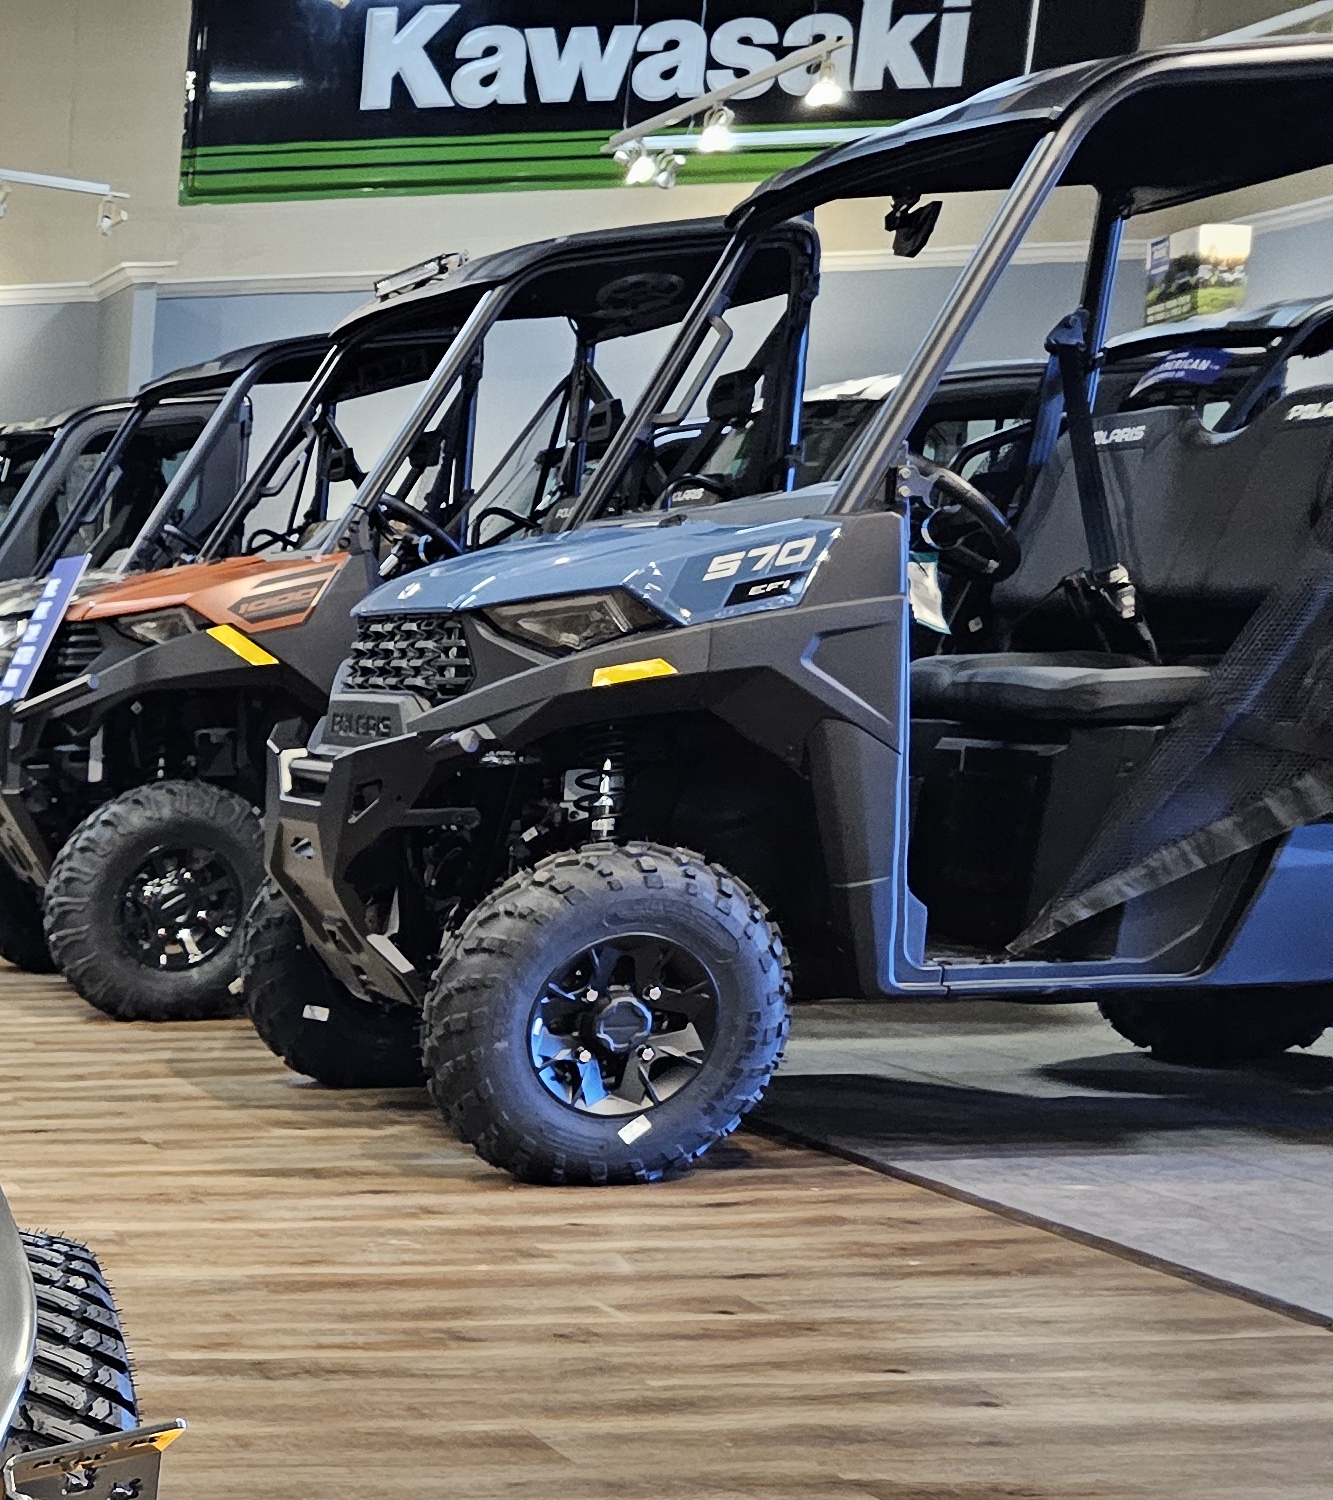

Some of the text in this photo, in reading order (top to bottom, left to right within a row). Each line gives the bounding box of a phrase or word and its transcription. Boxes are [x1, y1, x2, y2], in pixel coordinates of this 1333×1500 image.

[359, 0, 972, 111] Kawasaki
[1284, 400, 1333, 420] POLA
[702, 536, 818, 582] 570
[238, 587, 318, 614] 1000
